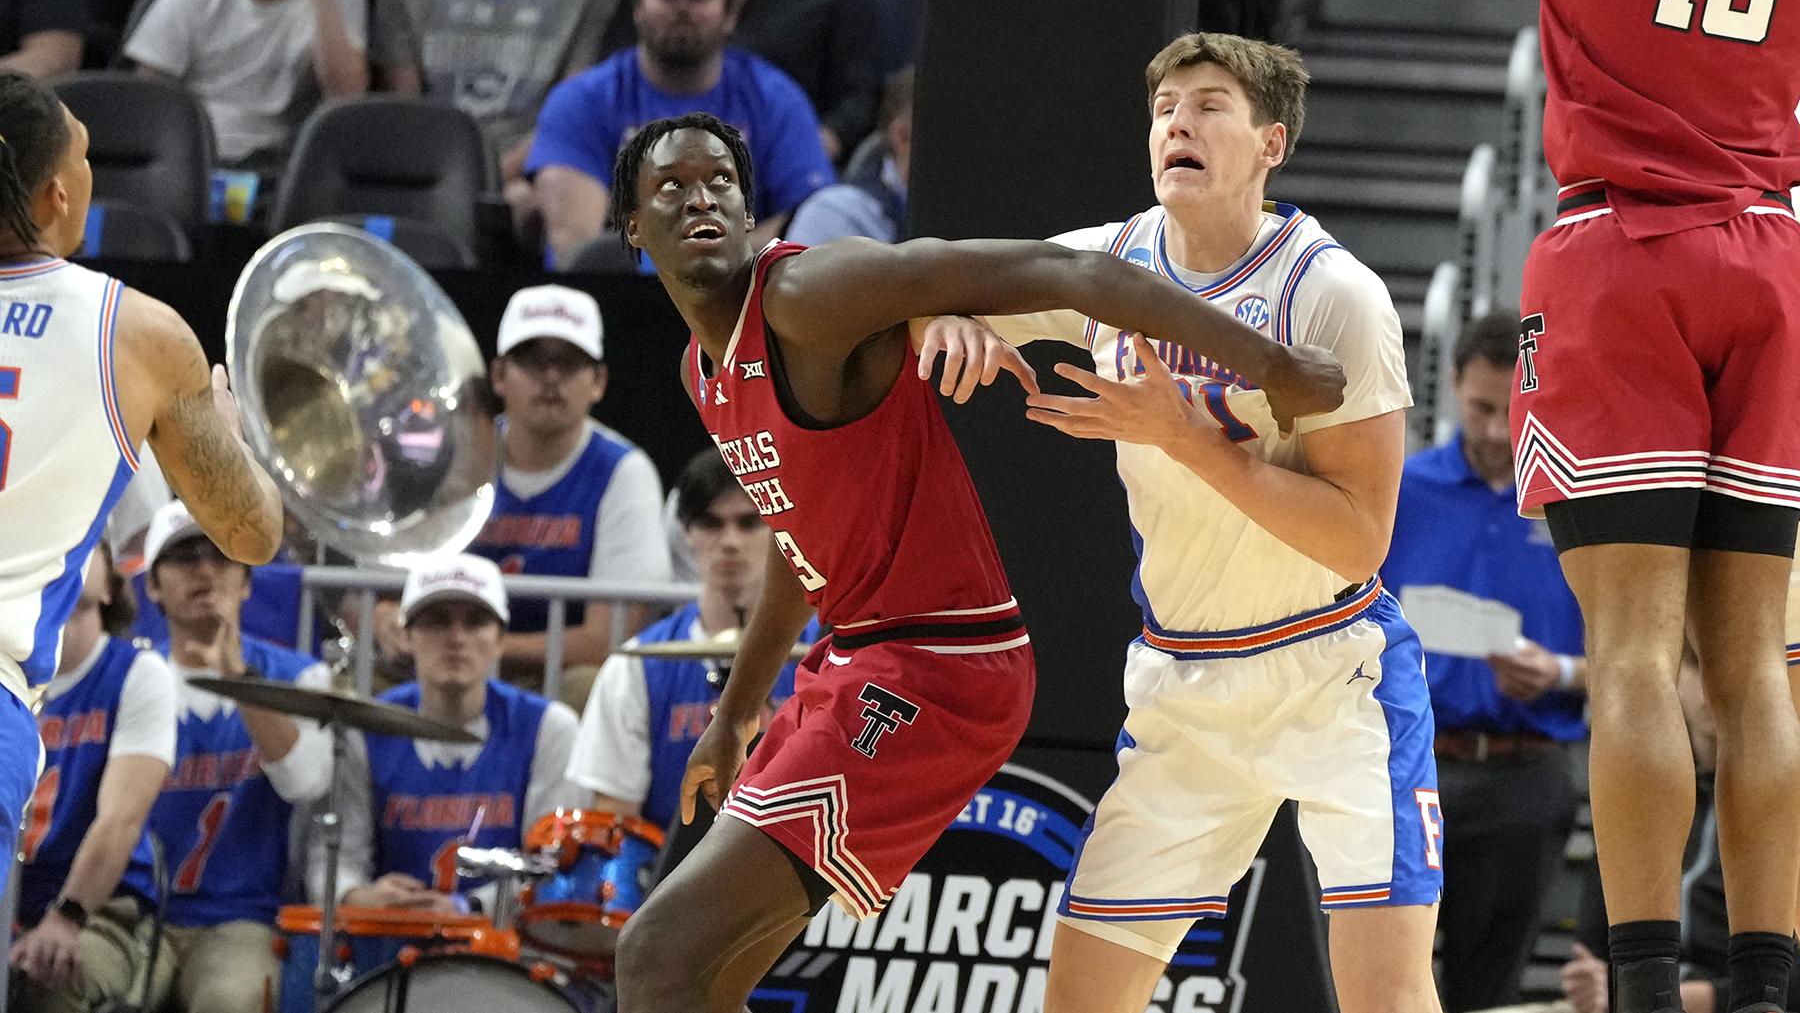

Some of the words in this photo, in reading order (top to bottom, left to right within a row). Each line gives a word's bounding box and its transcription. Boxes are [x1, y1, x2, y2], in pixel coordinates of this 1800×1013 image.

[1, 301, 53, 340] RD
[1236, 297, 1270, 330] SEC
[739, 359, 768, 380] XII
[774, 529, 828, 593] 3
[997, 799, 1039, 836] 16
